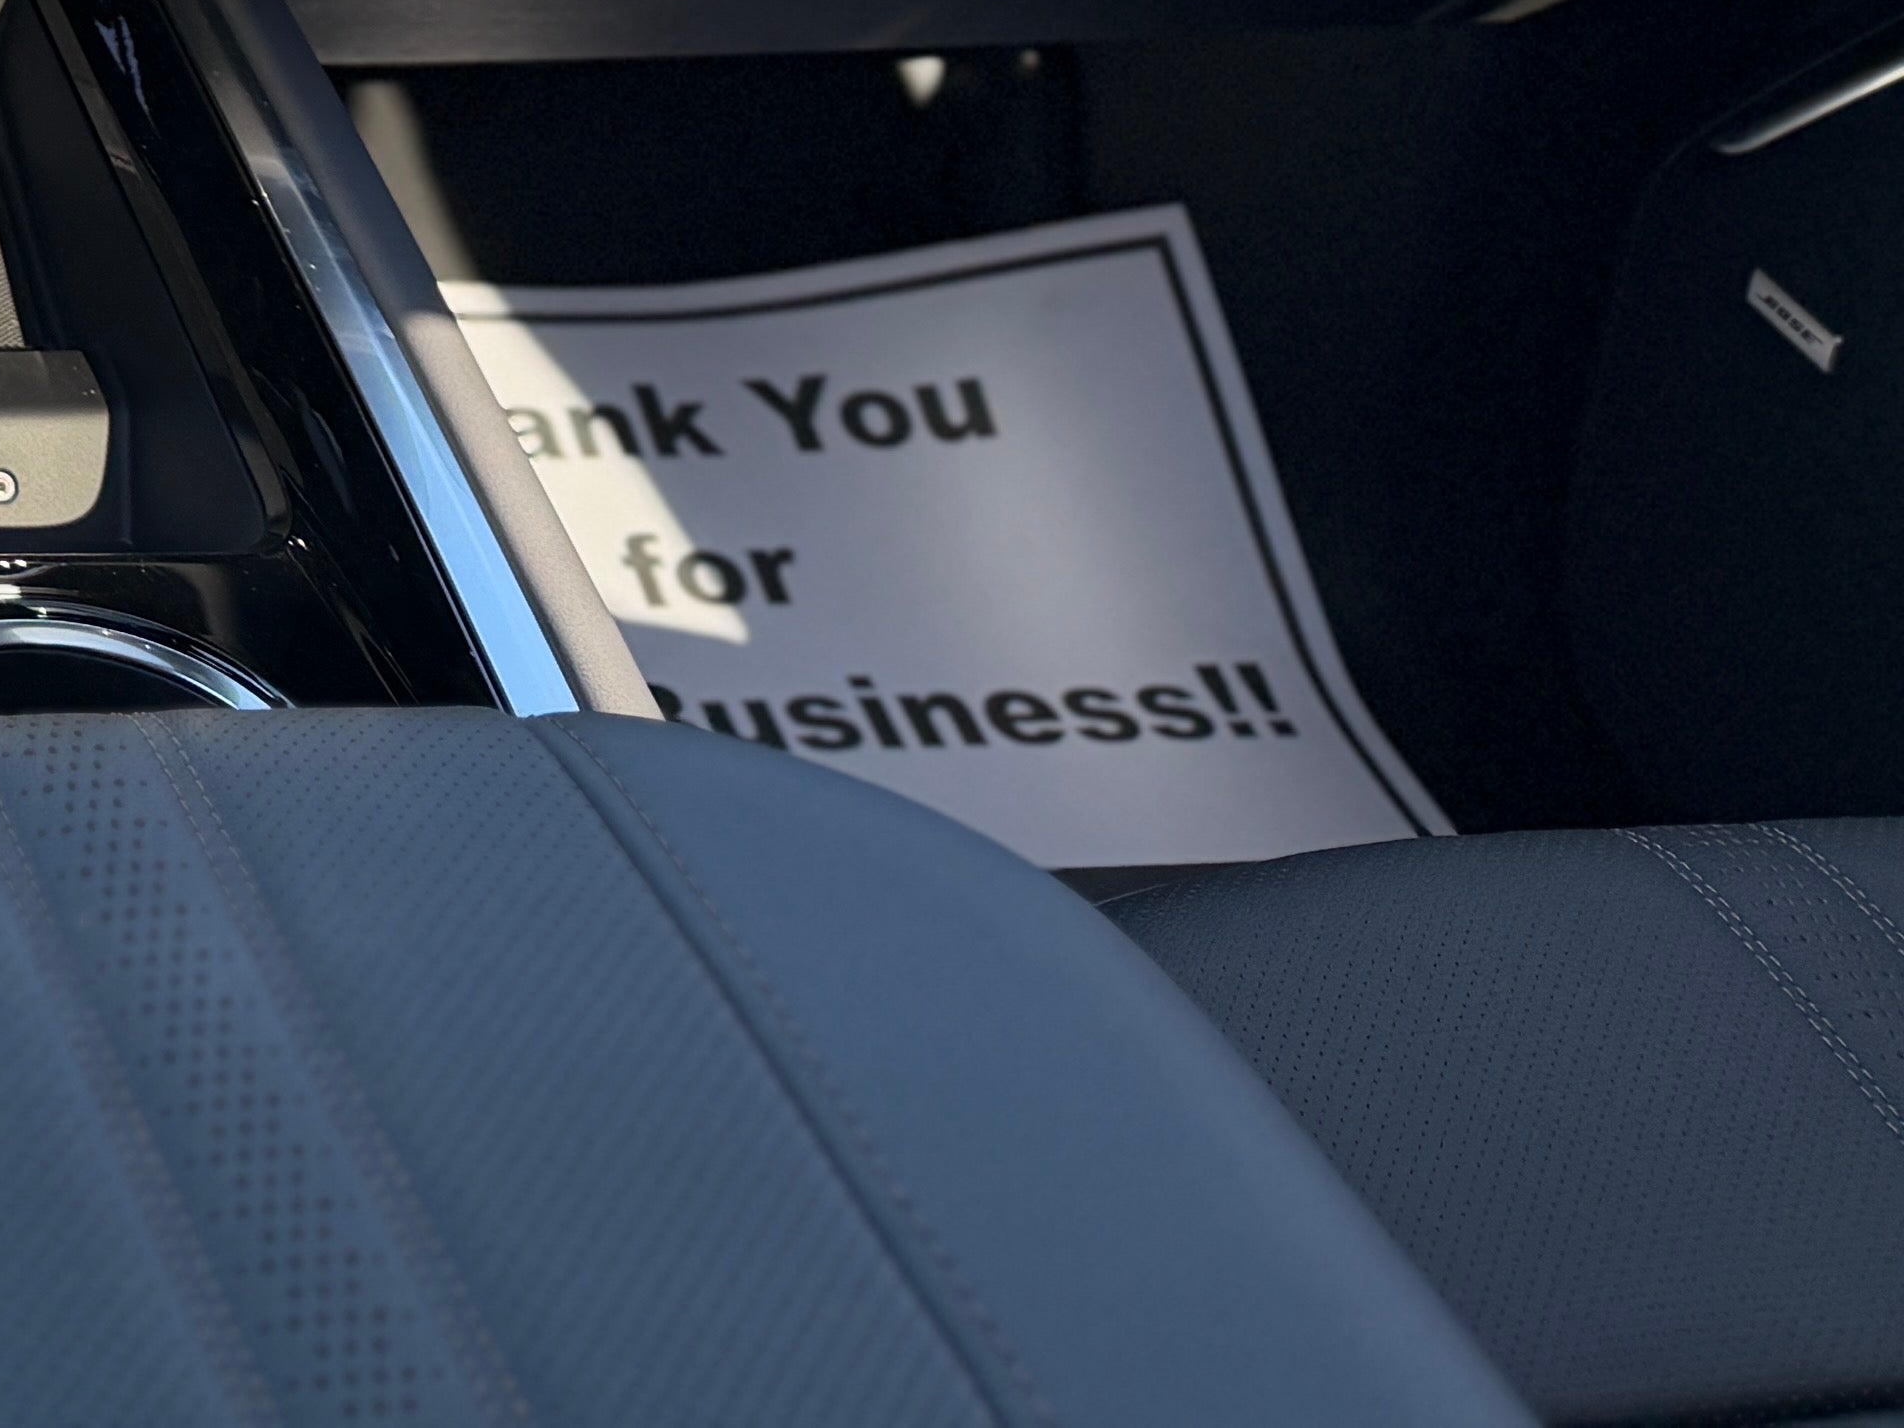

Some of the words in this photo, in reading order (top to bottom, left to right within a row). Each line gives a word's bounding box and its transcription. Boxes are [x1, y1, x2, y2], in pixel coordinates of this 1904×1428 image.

[506, 382, 726, 460] ank
[741, 373, 1000, 454] You
[620, 532, 796, 610] for
